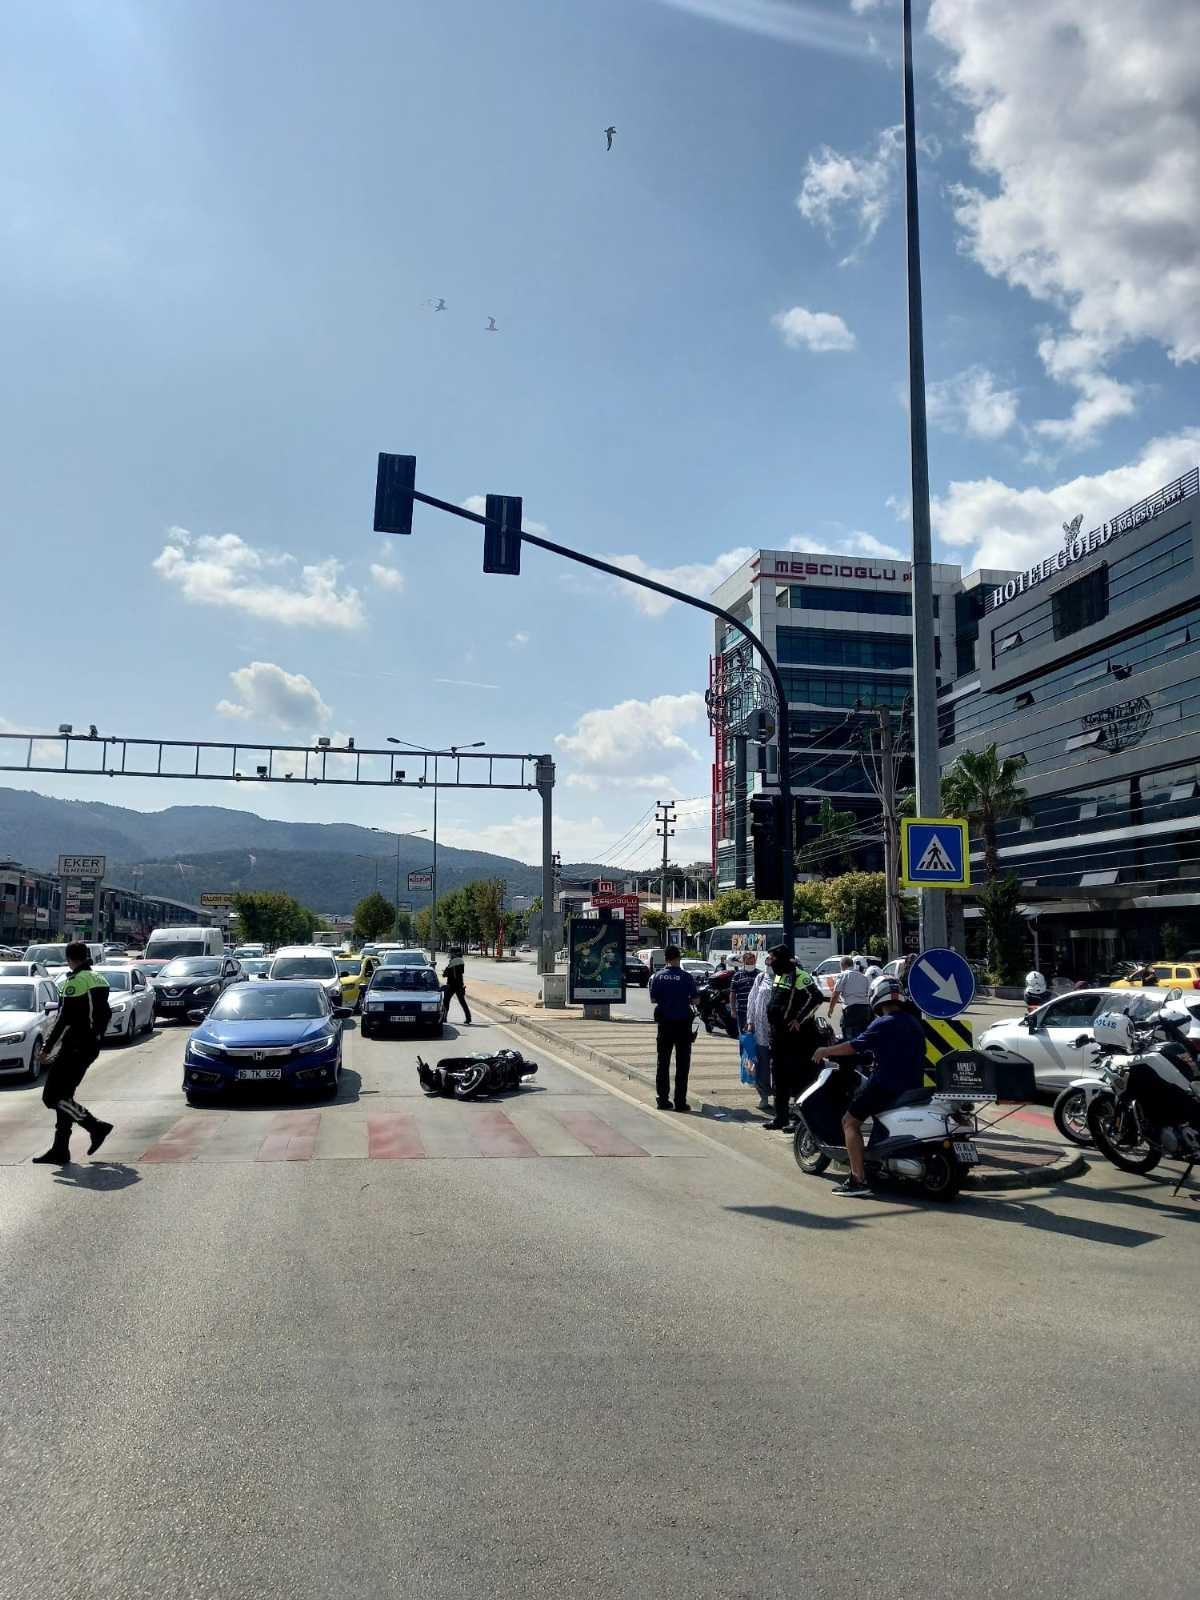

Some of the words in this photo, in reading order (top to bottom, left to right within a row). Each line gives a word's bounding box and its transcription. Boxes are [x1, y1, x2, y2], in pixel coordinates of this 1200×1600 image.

[993, 558, 1051, 608] HOTEL
[1056, 521, 1113, 571] GOLD
[1117, 504, 1155, 532] Majesty
[64, 858, 100, 868] EKER
[251, 1070, 262, 1079] TK
